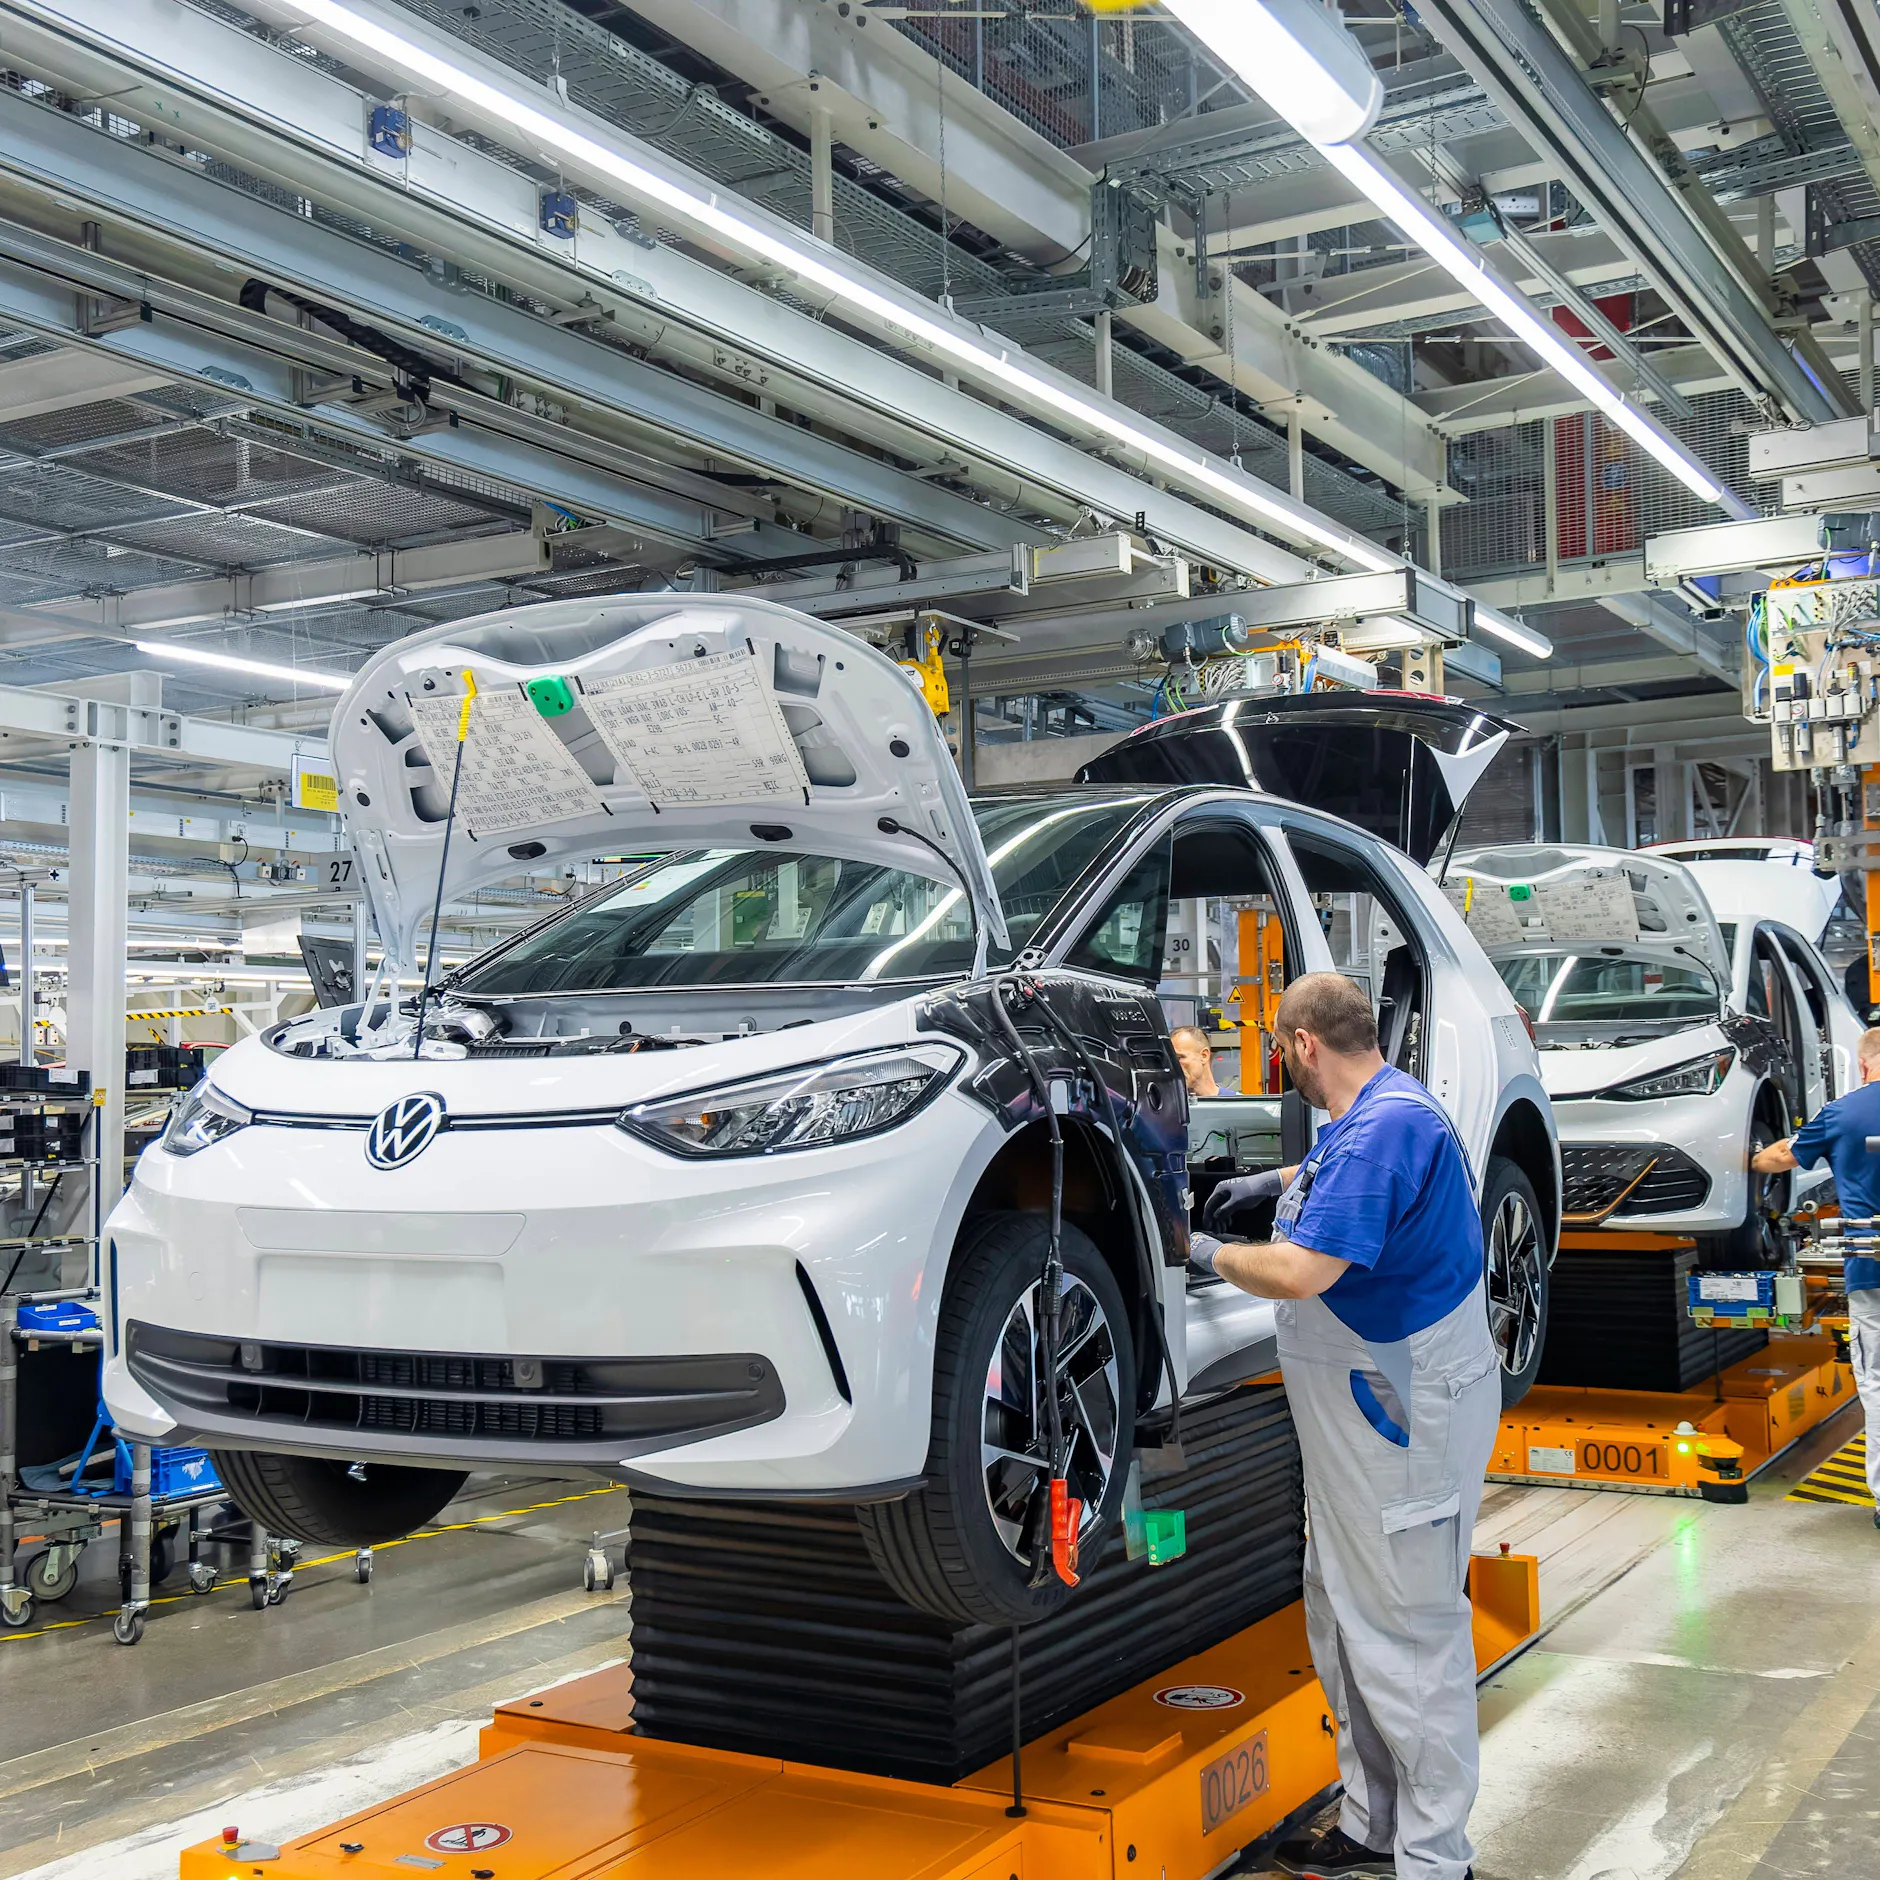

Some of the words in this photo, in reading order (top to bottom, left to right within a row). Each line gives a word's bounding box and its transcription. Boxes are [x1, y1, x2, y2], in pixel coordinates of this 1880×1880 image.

[674, 662, 693, 672] 5673
[330, 861, 352, 882] 27
[1172, 938, 1190, 952] 30
[1584, 1443, 1658, 1474] 0001
[1207, 1741, 1265, 1823] 0026
